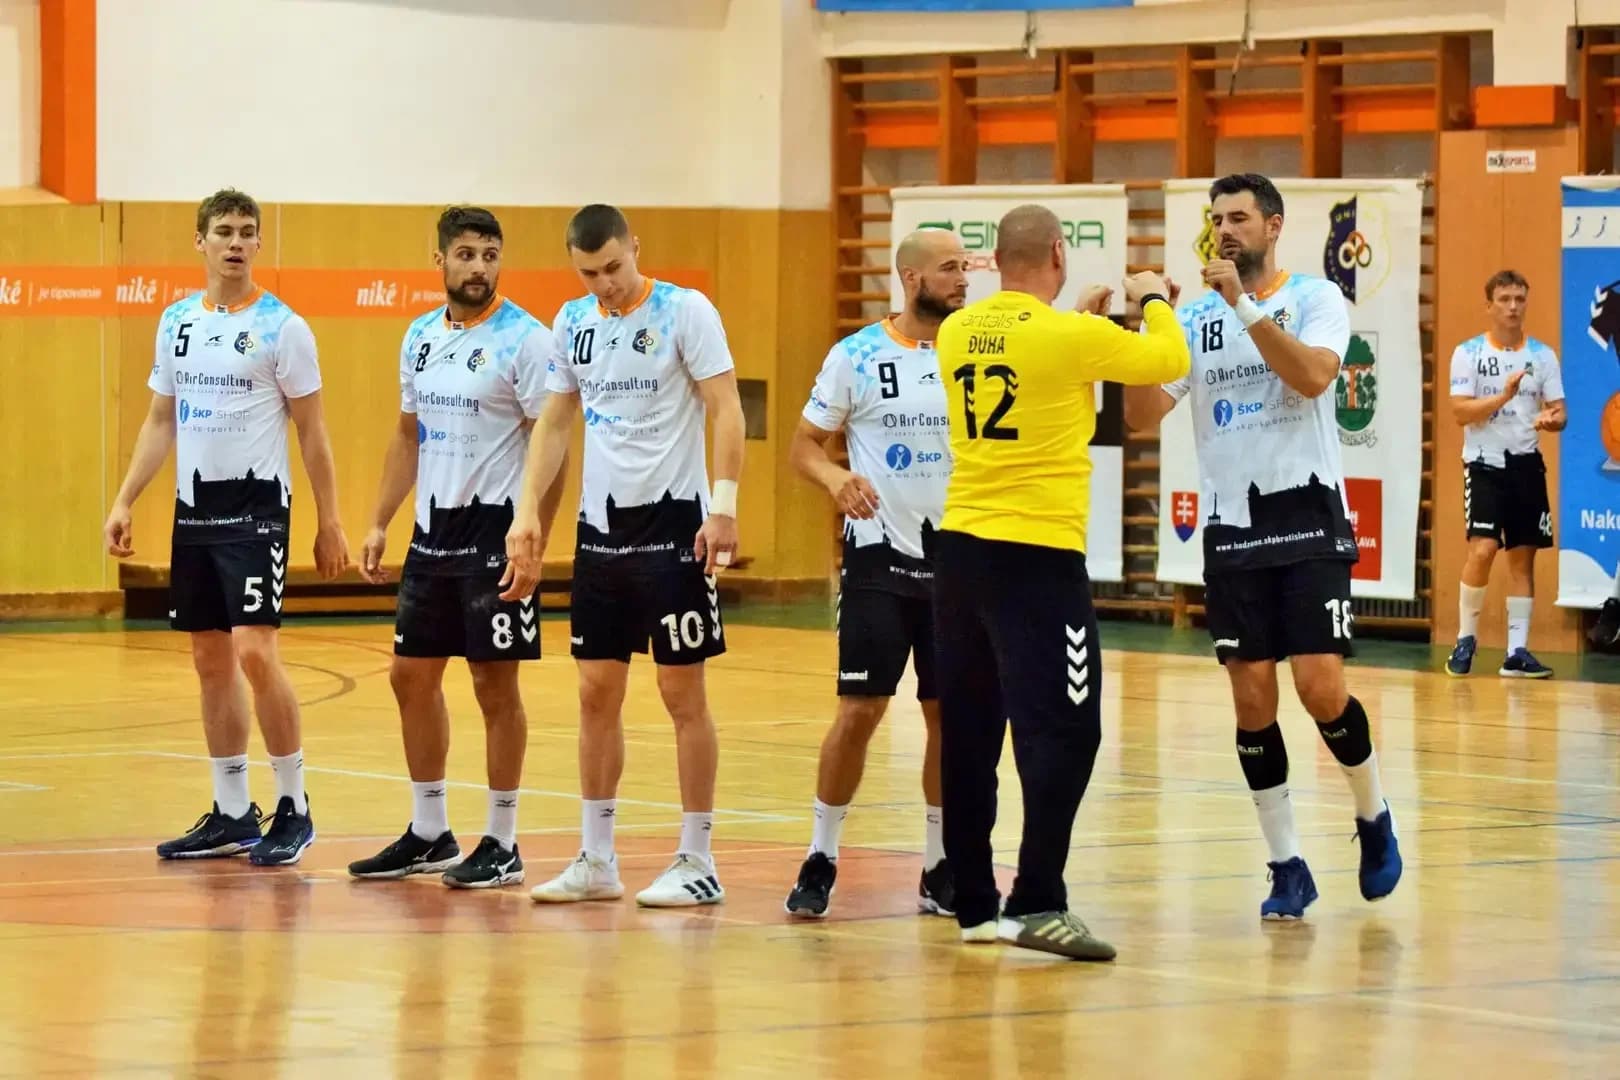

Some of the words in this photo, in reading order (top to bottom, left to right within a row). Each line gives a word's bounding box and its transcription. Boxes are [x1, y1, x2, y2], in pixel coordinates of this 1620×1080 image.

[960, 221, 1104, 248] SIRA
[0, 277, 21, 304] ké
[116, 276, 157, 304] niké
[356, 280, 397, 306] niké
[961, 313, 1015, 328] antalis
[175, 323, 193, 357] 5
[573, 328, 595, 365] 10
[1201, 319, 1224, 353] 18
[415, 343, 431, 372] 8
[1477, 357, 1500, 376] 48
[185, 372, 252, 391] AirConsulting
[878, 362, 899, 399] 9
[1218, 363, 1273, 383] AirConsu
[192, 406, 213, 419] ŠKP
[216, 410, 250, 420] SHOP
[953, 363, 1019, 440] 12
[1238, 402, 1263, 415] ŠKP
[1269, 396, 1304, 410] SHOP
[900, 413, 951, 428] AirCons
[430, 428, 447, 441] ŠKP
[917, 450, 942, 463] ŠKP
[1538, 511, 1553, 536] 48
[243, 577, 264, 612] 5
[491, 612, 514, 649] 8
[660, 610, 705, 651] 10
